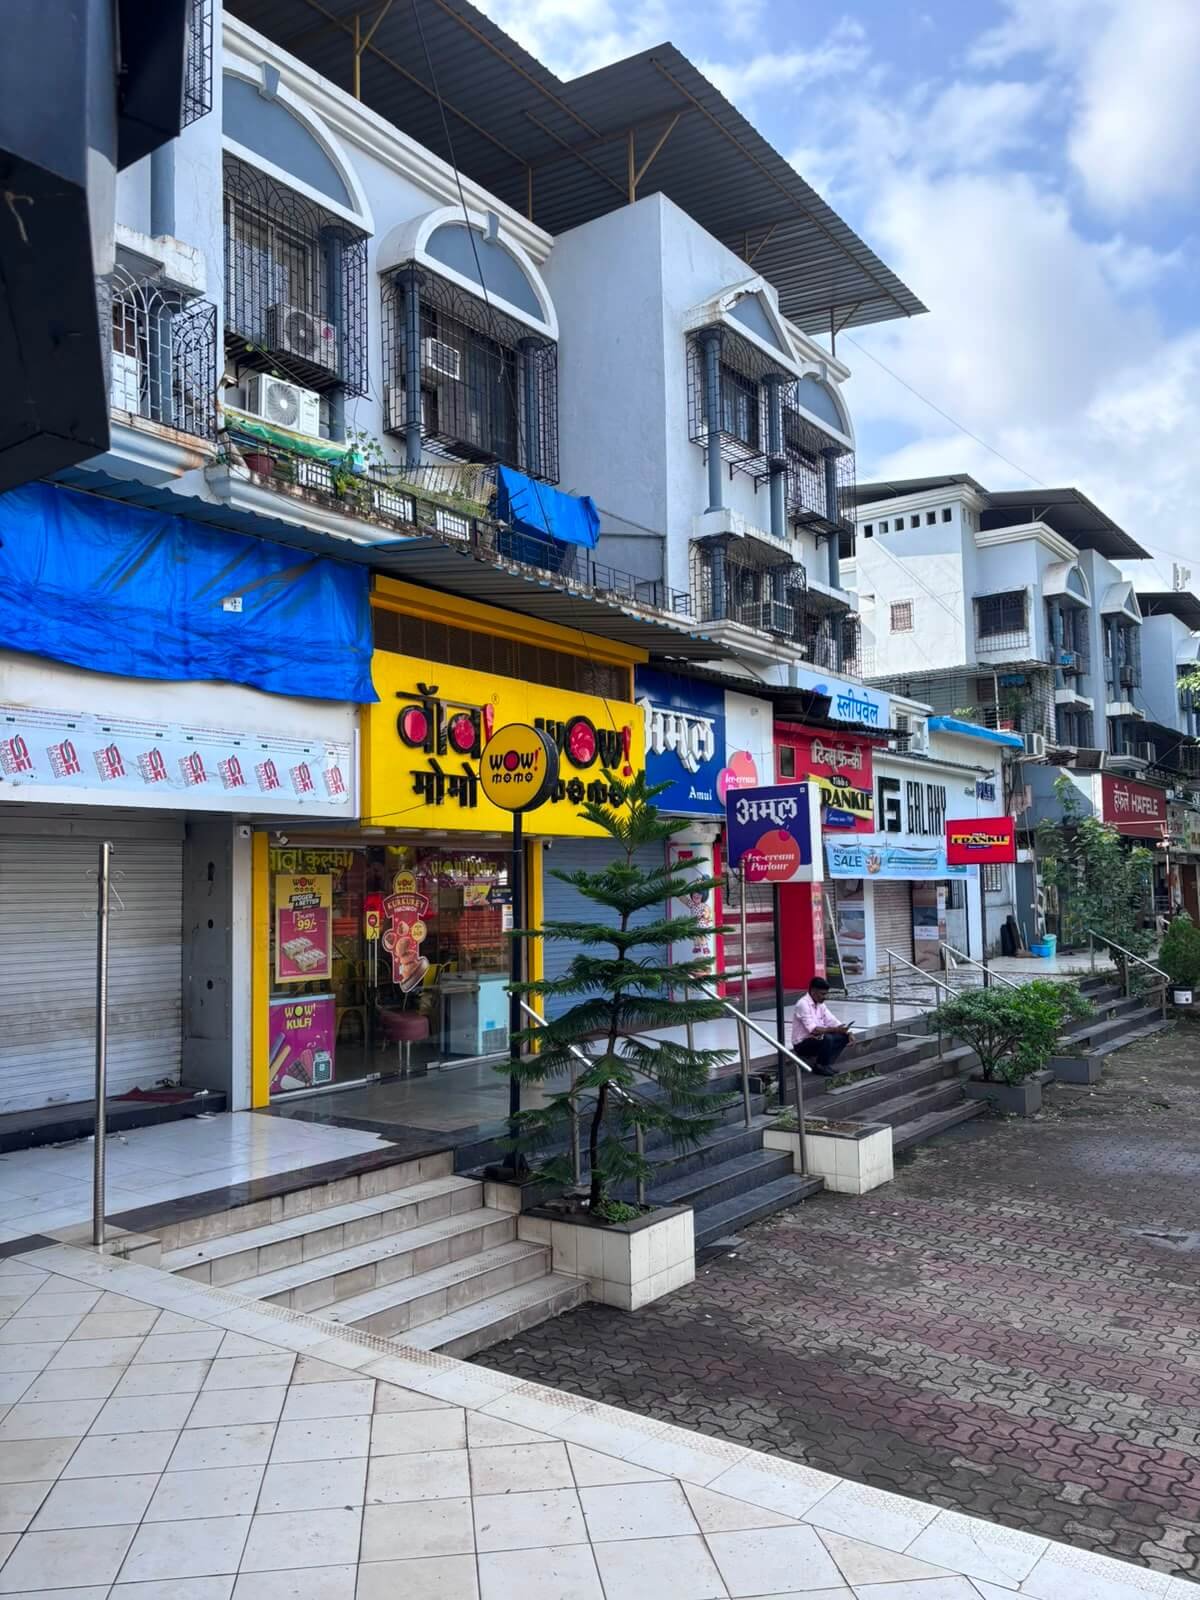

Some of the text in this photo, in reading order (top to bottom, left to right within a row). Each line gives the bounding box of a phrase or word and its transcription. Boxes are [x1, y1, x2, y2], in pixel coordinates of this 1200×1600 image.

[837, 688, 879, 724] स्लीपवेल
[489, 748, 539, 772] WOW!
[409, 757, 481, 807] मोमो
[492, 772, 533, 784] momo
[688, 786, 713, 801] Amul
[819, 787, 873, 811] RANKIE
[736, 797, 797, 826] अमूल
[907, 781, 946, 836] GALAXY
[746, 852, 795, 862] Ice-cream
[751, 861, 789, 872] Parlour
[833, 854, 863, 868] SALE
[284, 1003, 316, 1019] WOW!
